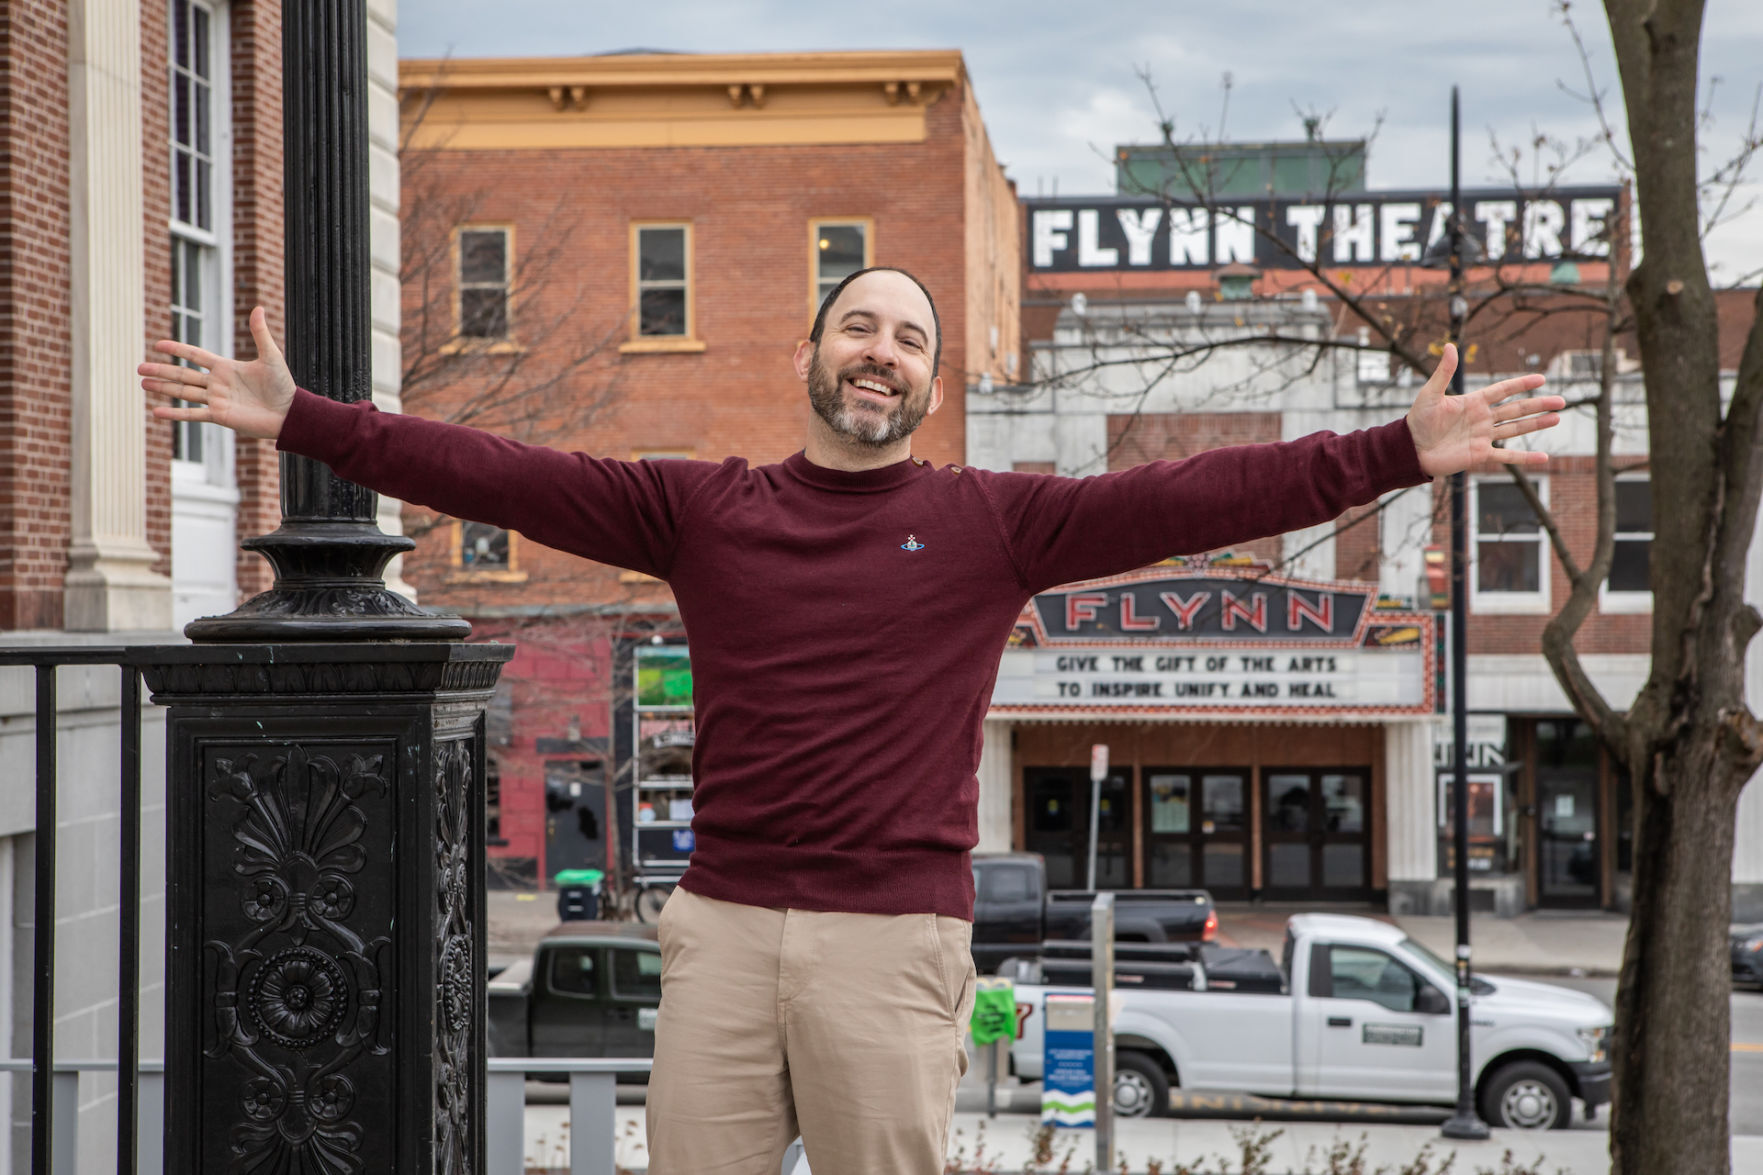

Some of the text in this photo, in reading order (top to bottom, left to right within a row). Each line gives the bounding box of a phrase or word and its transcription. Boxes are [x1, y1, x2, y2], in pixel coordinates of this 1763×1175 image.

[1033, 207, 1255, 267] FLYNN
[1066, 590, 1333, 633] FLYNN
[1057, 656, 1336, 672] GIVE THE GIFT OF THE ARTS
[1057, 682, 1336, 697] TO INSPIRE UNIFY AND HEAL
